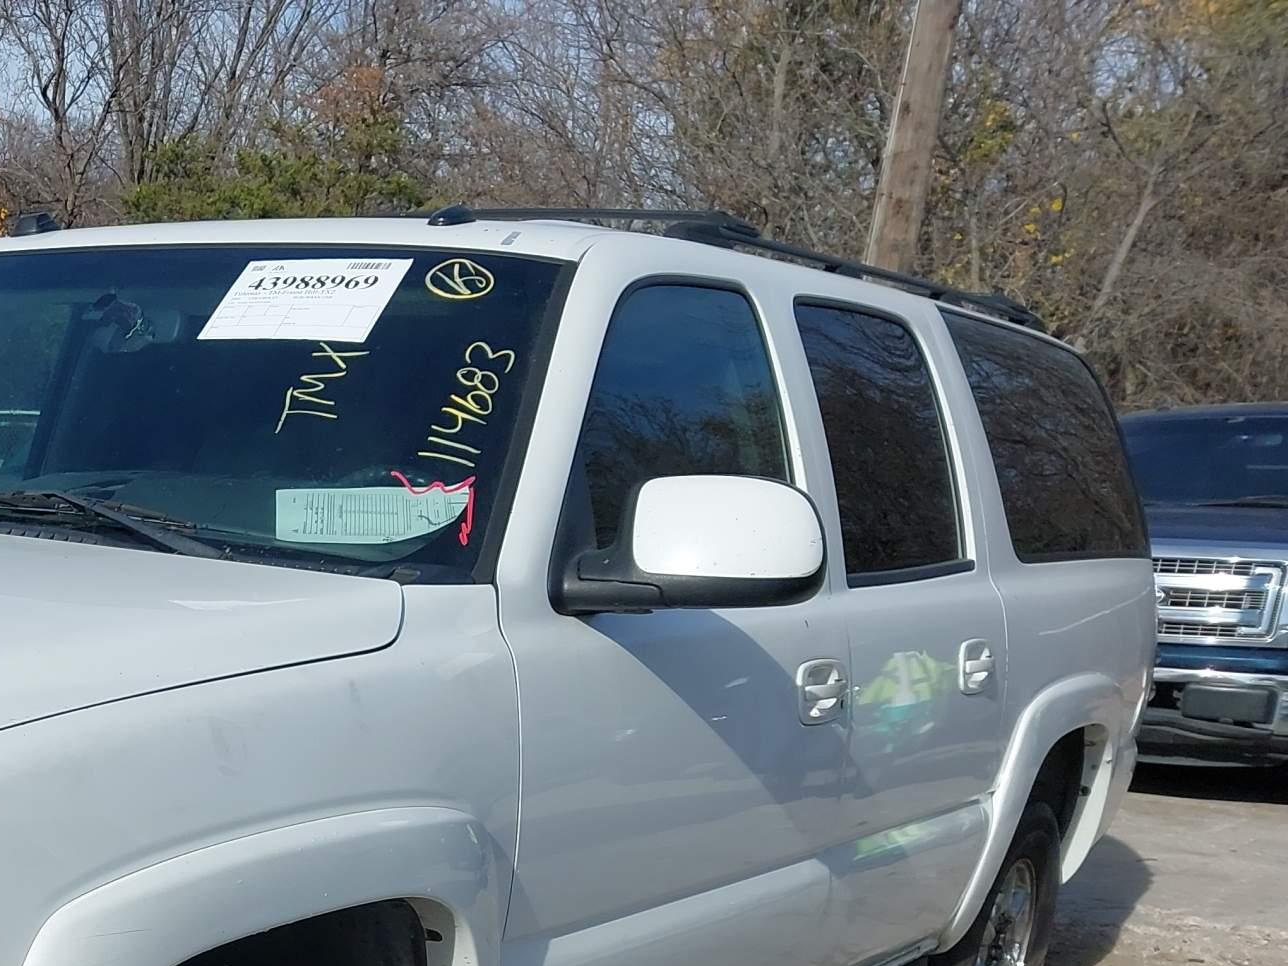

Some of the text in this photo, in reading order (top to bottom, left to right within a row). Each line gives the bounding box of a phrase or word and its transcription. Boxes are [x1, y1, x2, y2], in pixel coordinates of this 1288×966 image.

[248, 275, 380, 291] 43988969
[275, 342, 370, 434] TMX
[418, 341, 516, 468] 114683
